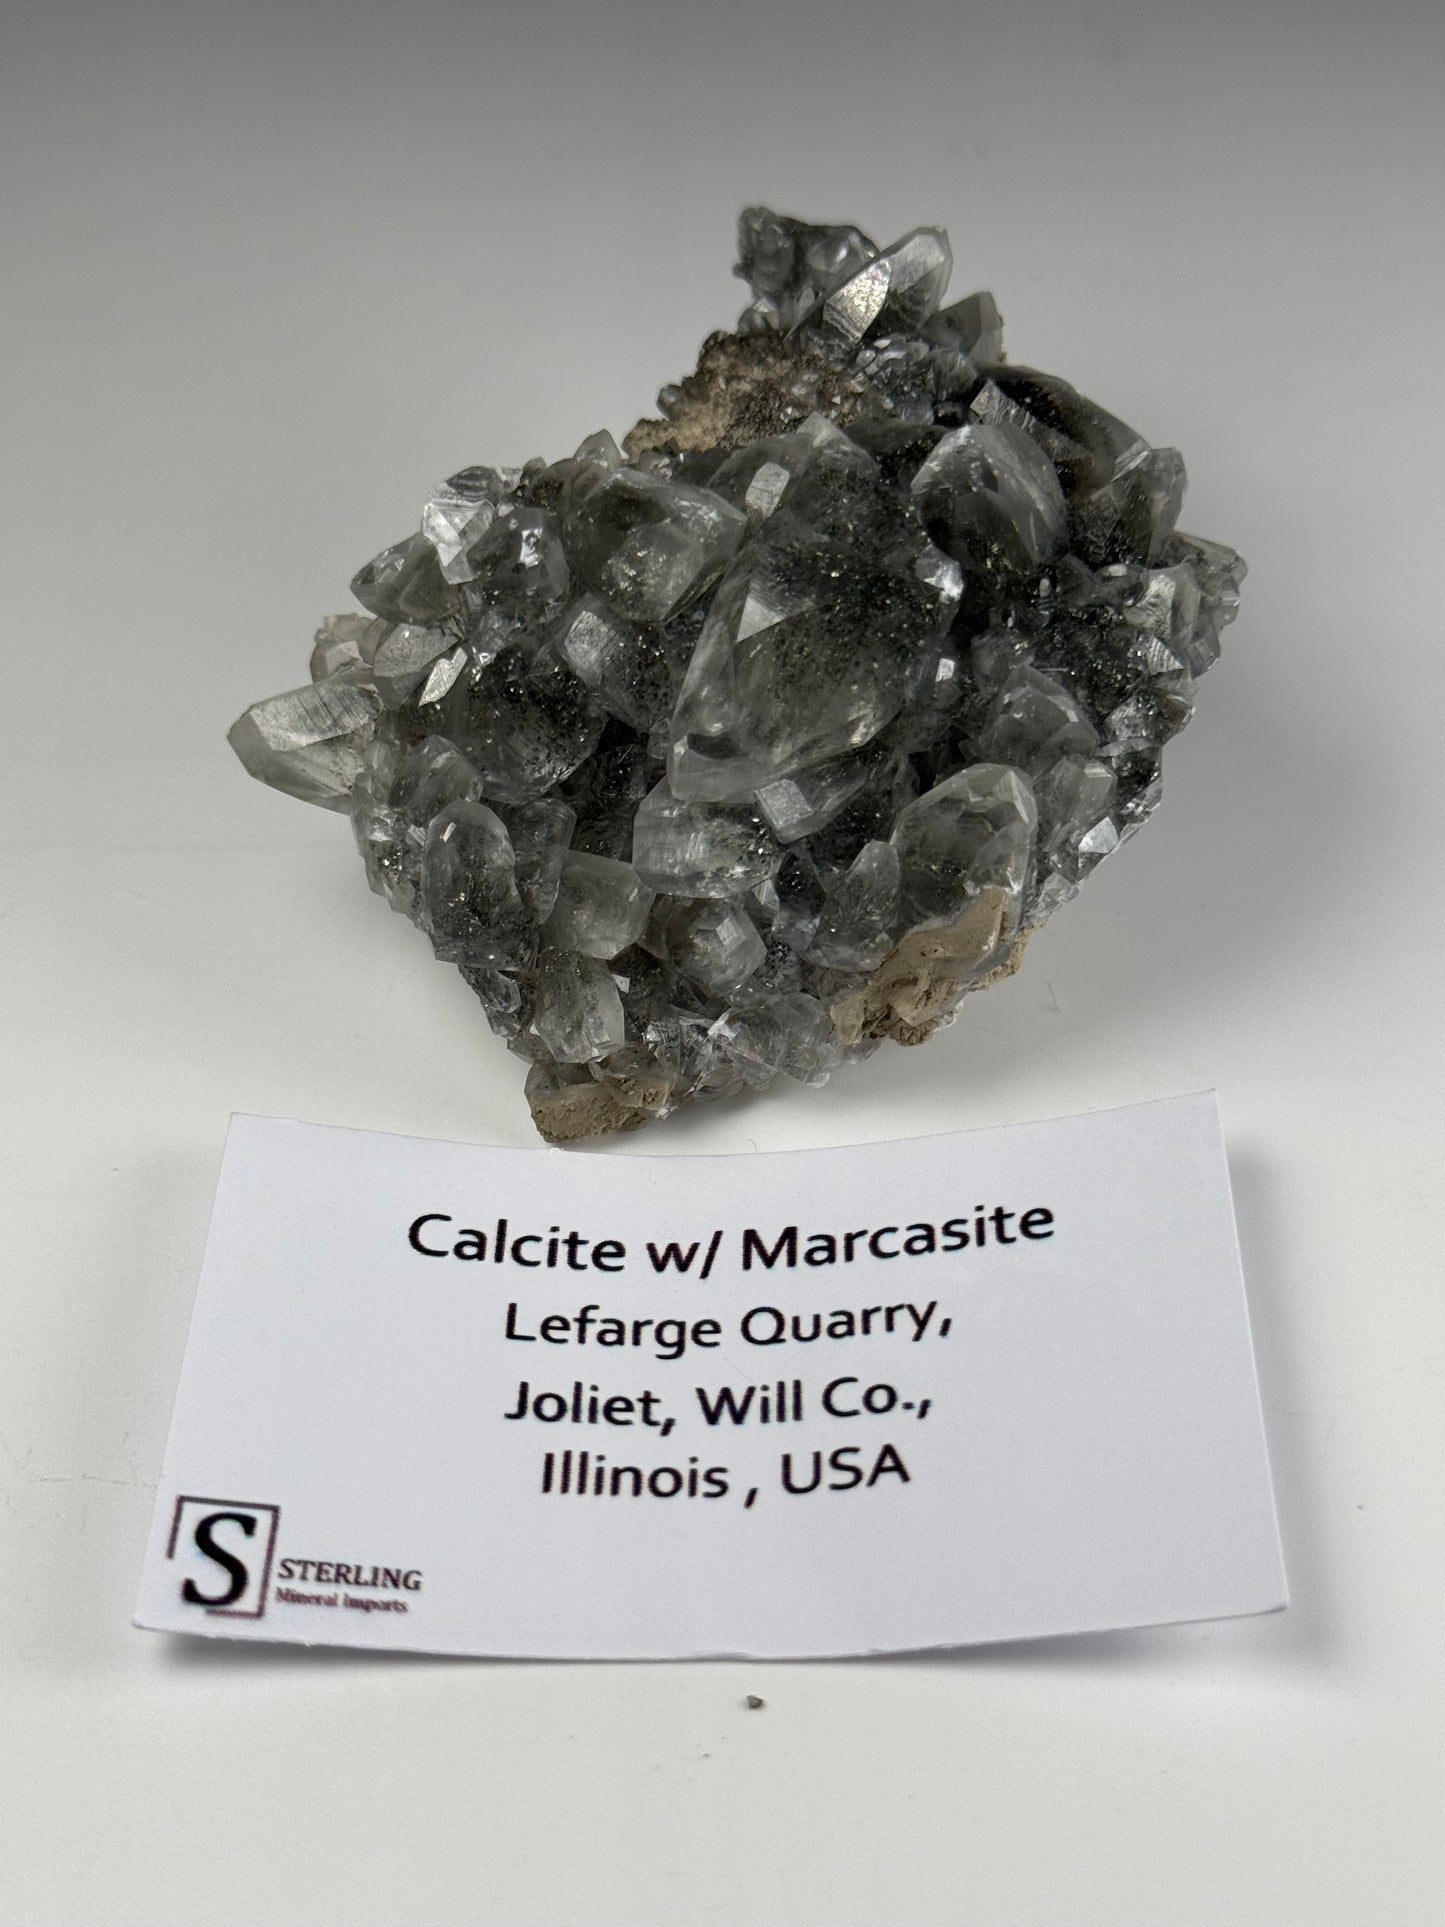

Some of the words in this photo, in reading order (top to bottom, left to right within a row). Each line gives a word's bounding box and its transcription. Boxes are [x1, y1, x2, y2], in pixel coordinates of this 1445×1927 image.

[408, 1213, 626, 1273] Calcite
[646, 1231, 724, 1280] w/
[742, 1205, 1055, 1272] Marcasite
[505, 1303, 722, 1361] Lefarge
[741, 1301, 952, 1346] Quarry,
[504, 1381, 676, 1437] Joliet,
[696, 1380, 803, 1426] Will
[822, 1377, 932, 1420] Co.,
[782, 1444, 911, 1495] USA
[181, 1511, 258, 1606] S
[277, 1558, 423, 1592] STERLING
[275, 1586, 340, 1608] Mineral
[342, 1592, 409, 1614] Imports
